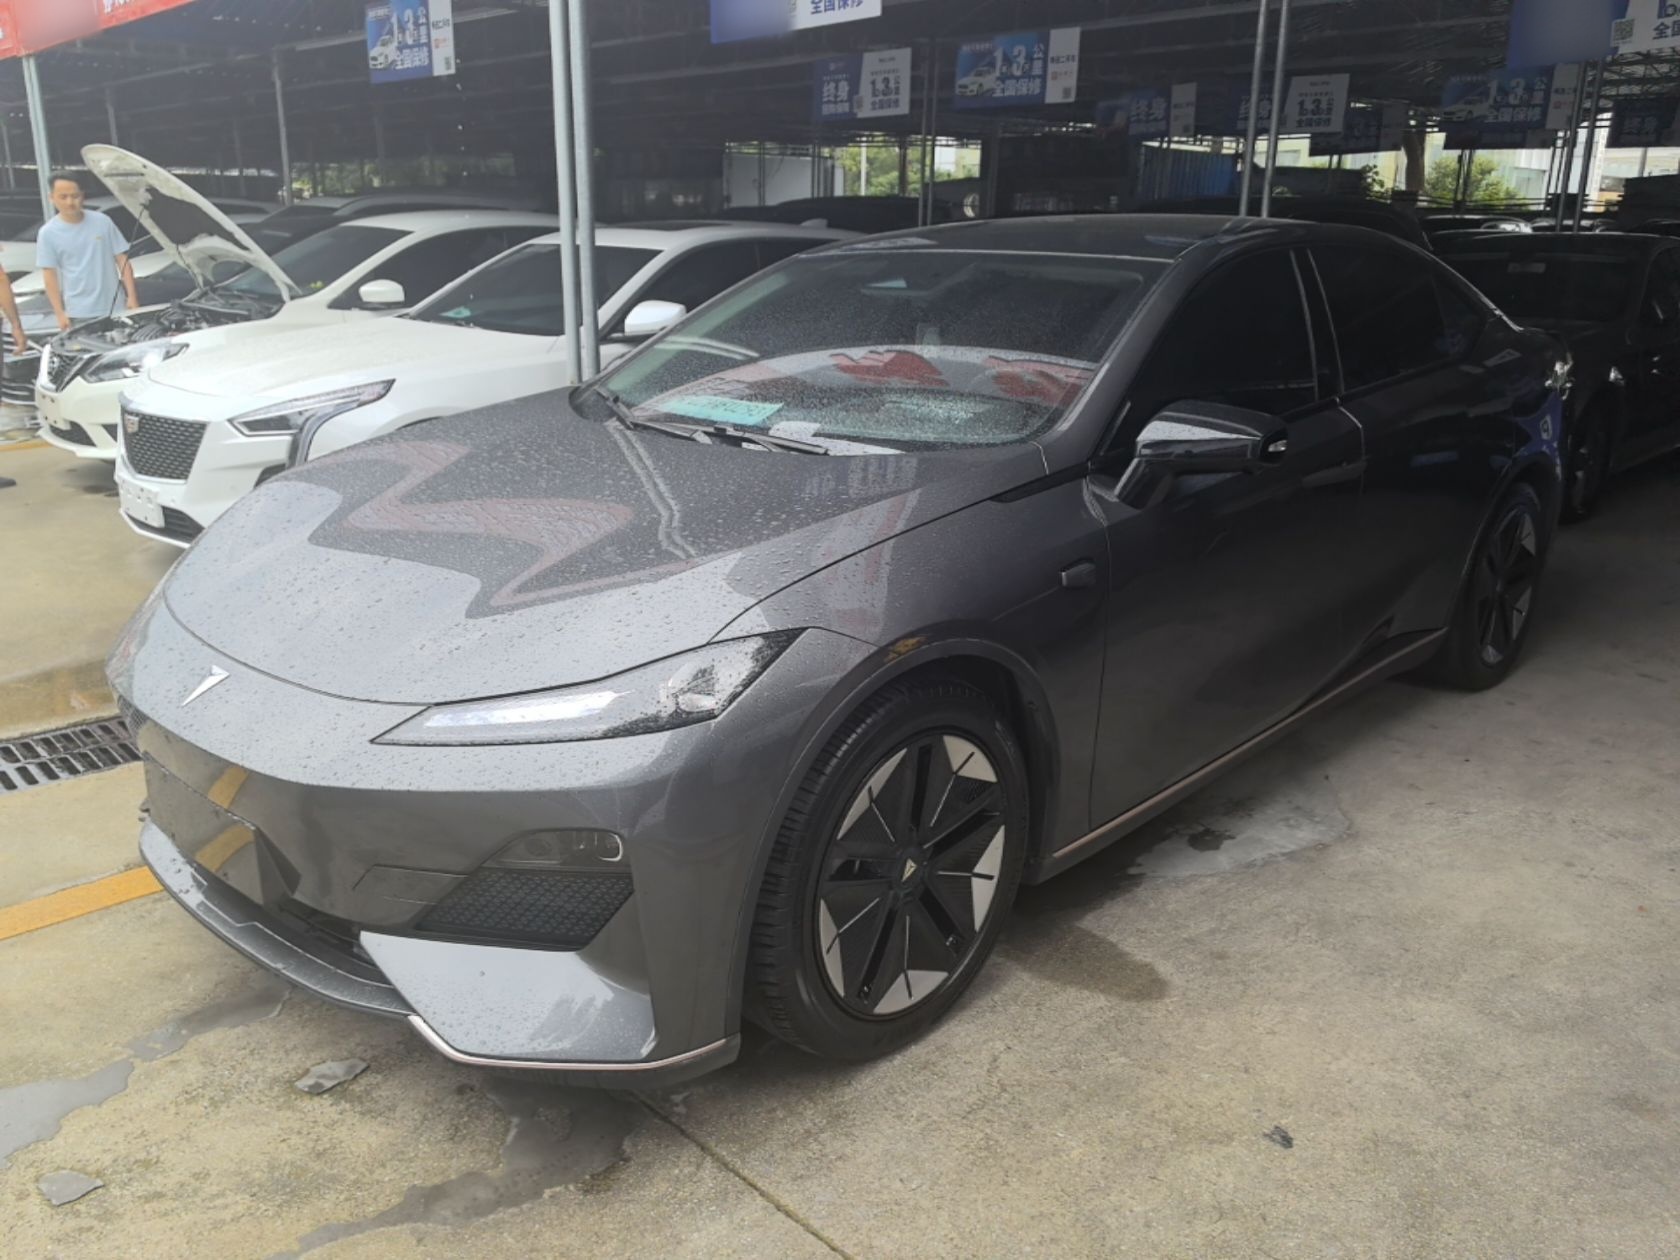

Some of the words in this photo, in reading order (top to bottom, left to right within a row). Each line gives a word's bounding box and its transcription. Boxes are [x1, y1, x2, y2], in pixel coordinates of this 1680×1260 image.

[822, 80, 850, 102] 终身
[992, 78, 1042, 98] 全国保修
